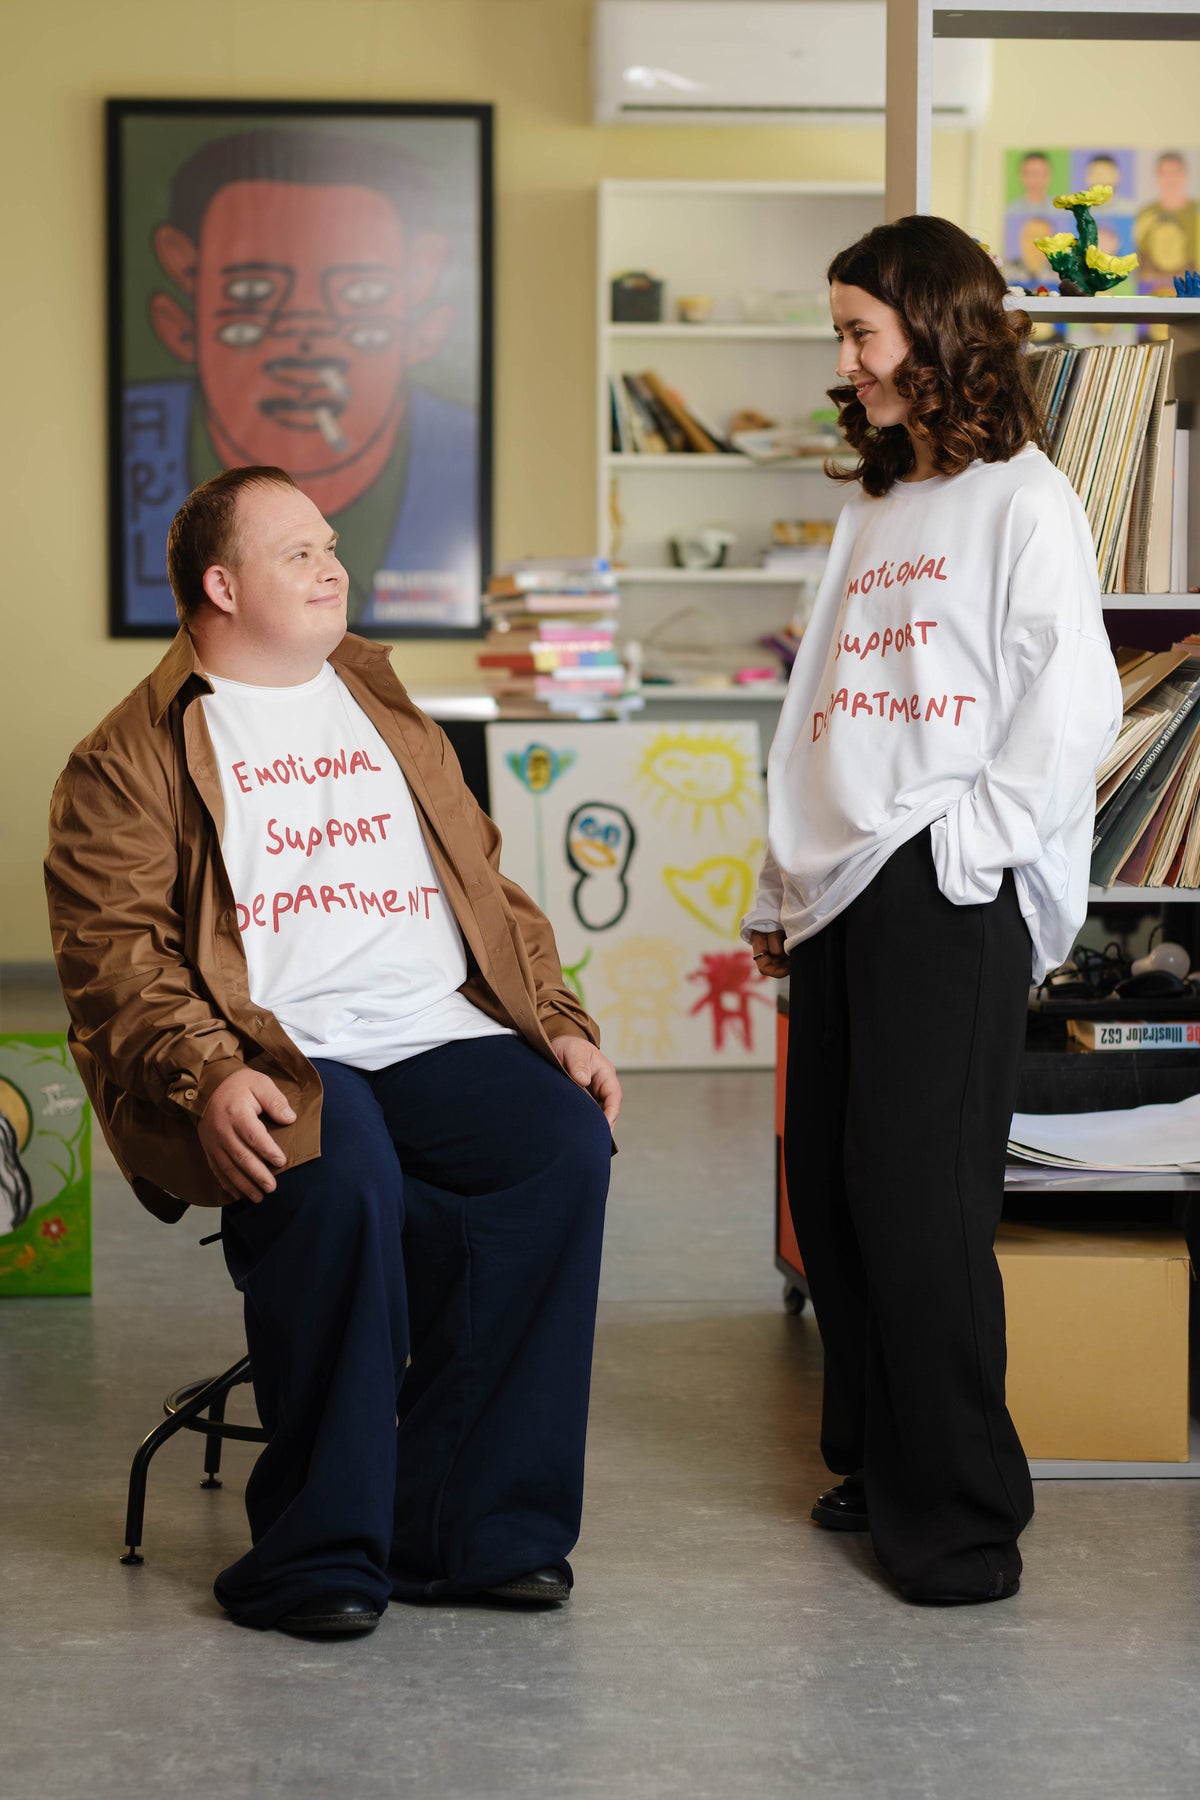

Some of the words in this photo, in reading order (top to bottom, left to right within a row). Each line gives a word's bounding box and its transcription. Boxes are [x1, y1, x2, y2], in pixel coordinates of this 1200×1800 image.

[1161, 698, 1194, 742] MEYERBEER
[1101, 1028, 1122, 1044] CS2
[1127, 1026, 1182, 1043] Illustrator
